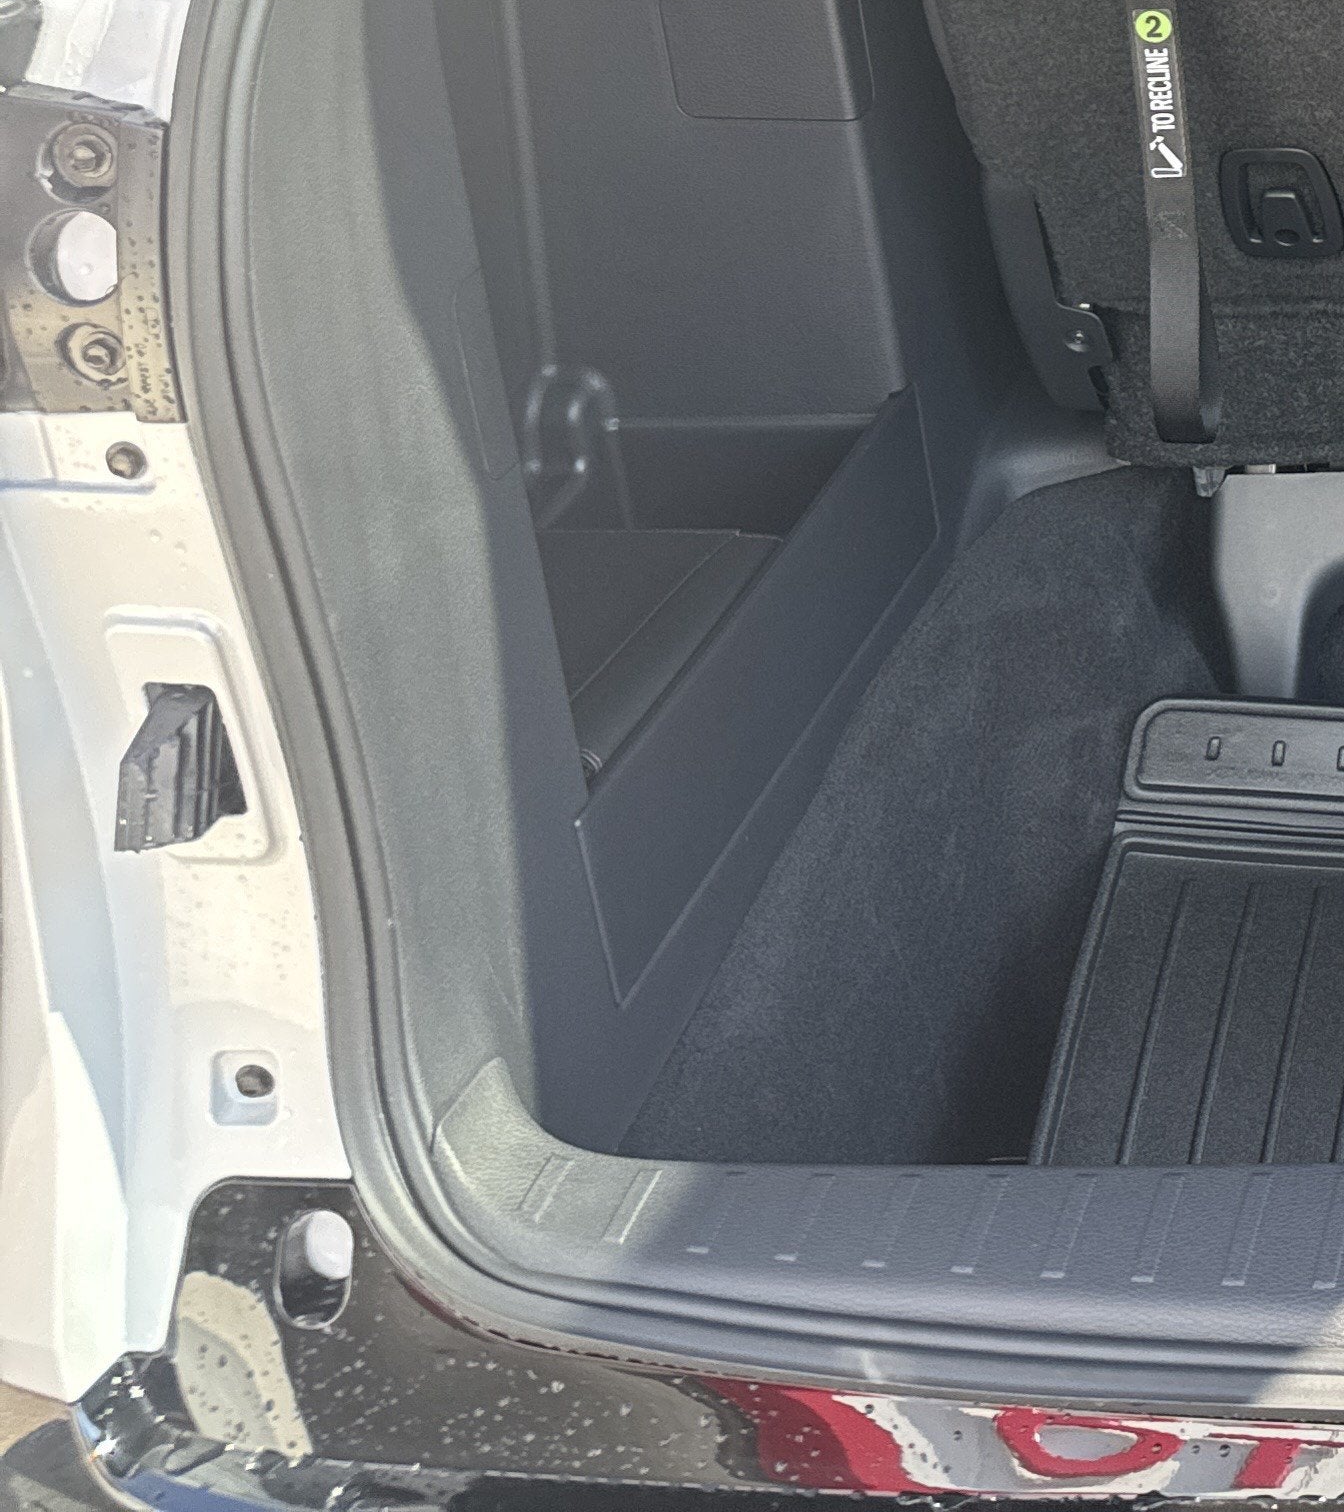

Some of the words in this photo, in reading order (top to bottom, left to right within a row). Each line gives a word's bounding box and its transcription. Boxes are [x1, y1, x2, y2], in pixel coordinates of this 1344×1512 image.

[1145, 15, 1163, 38] 2
[1144, 48, 1174, 111] RECLINE
[1151, 113, 1176, 133] TO
